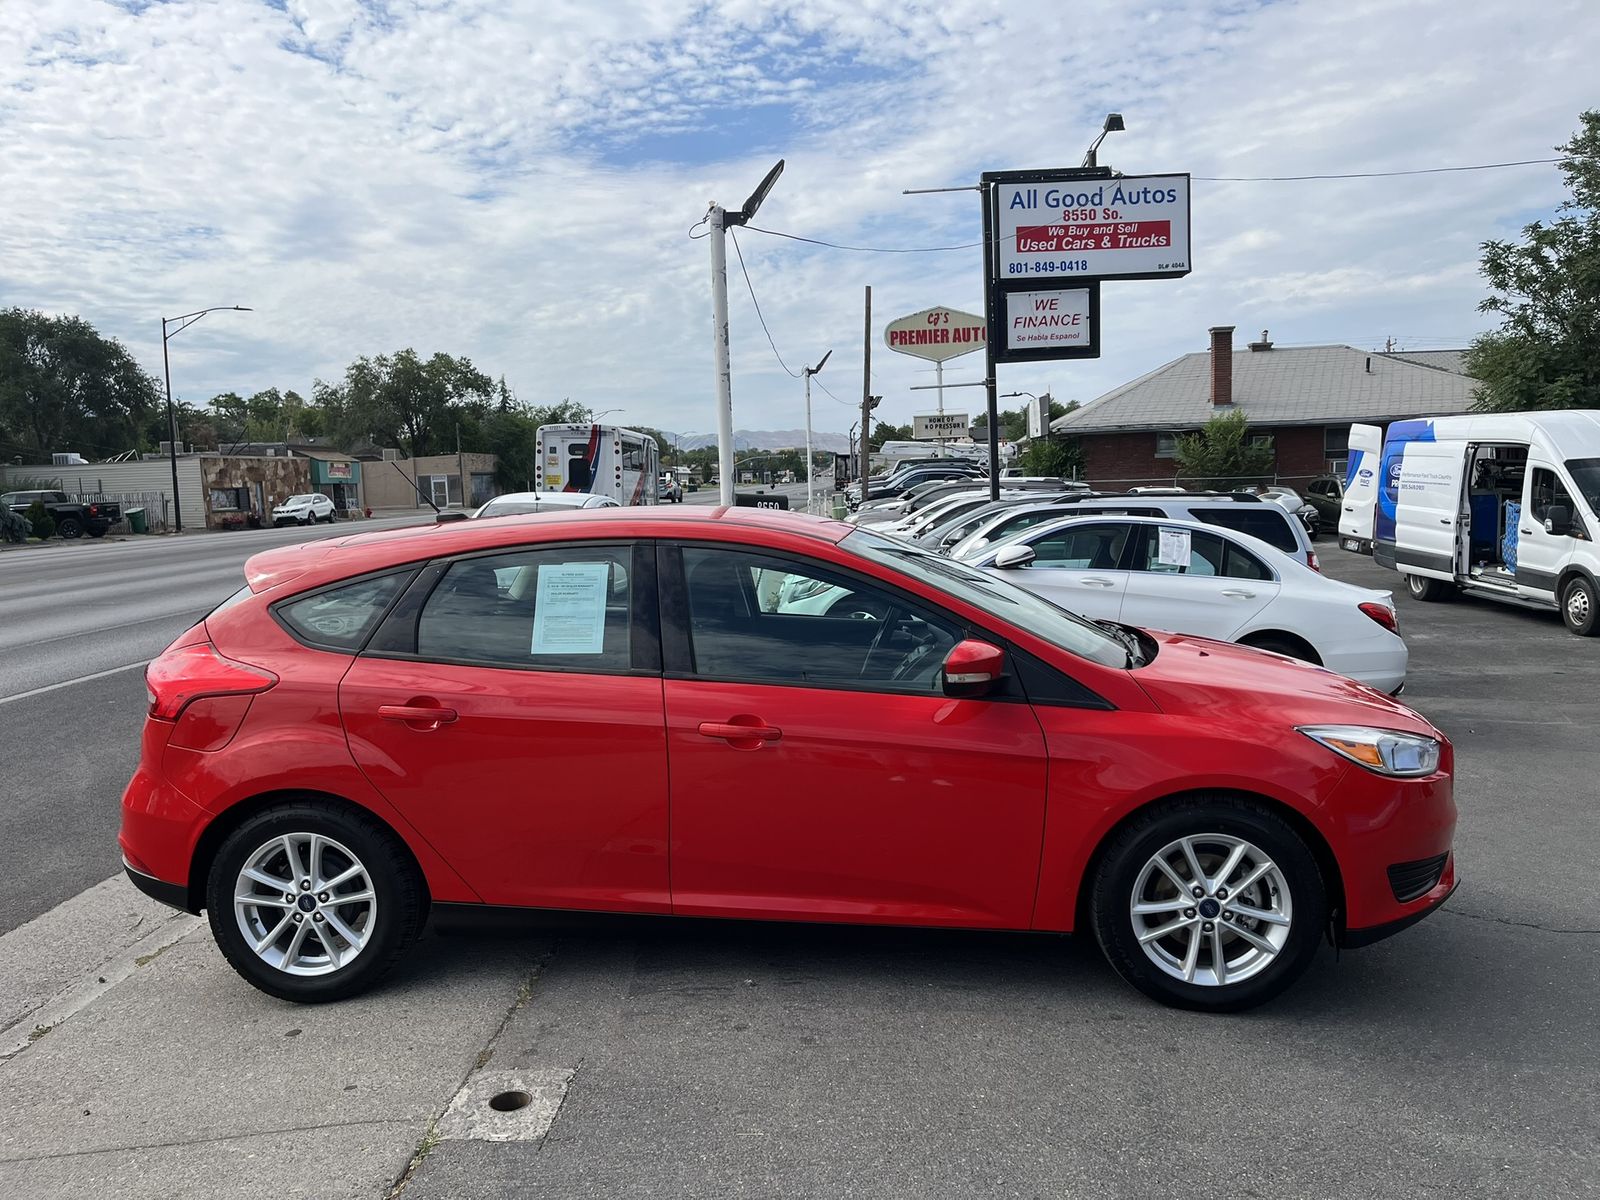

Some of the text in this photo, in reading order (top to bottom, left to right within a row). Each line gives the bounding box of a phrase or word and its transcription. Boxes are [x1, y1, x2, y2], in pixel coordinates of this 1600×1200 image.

[1009, 186, 1177, 209] All Good Autos
[1063, 208, 1123, 221] 8550 So.
[1048, 223, 1138, 237] We Buy and Sell
[1019, 234, 1168, 252] Used Cars & Trucks
[1009, 260, 1088, 274] 801-849-0418
[1035, 298, 1059, 311] WE
[1013, 313, 1082, 329] FINANCE
[890, 328, 950, 346] PREMIER
[1027, 333, 1048, 341] Habla
[1050, 332, 1080, 341] Espanol
[935, 422, 965, 430] PRESSURE
